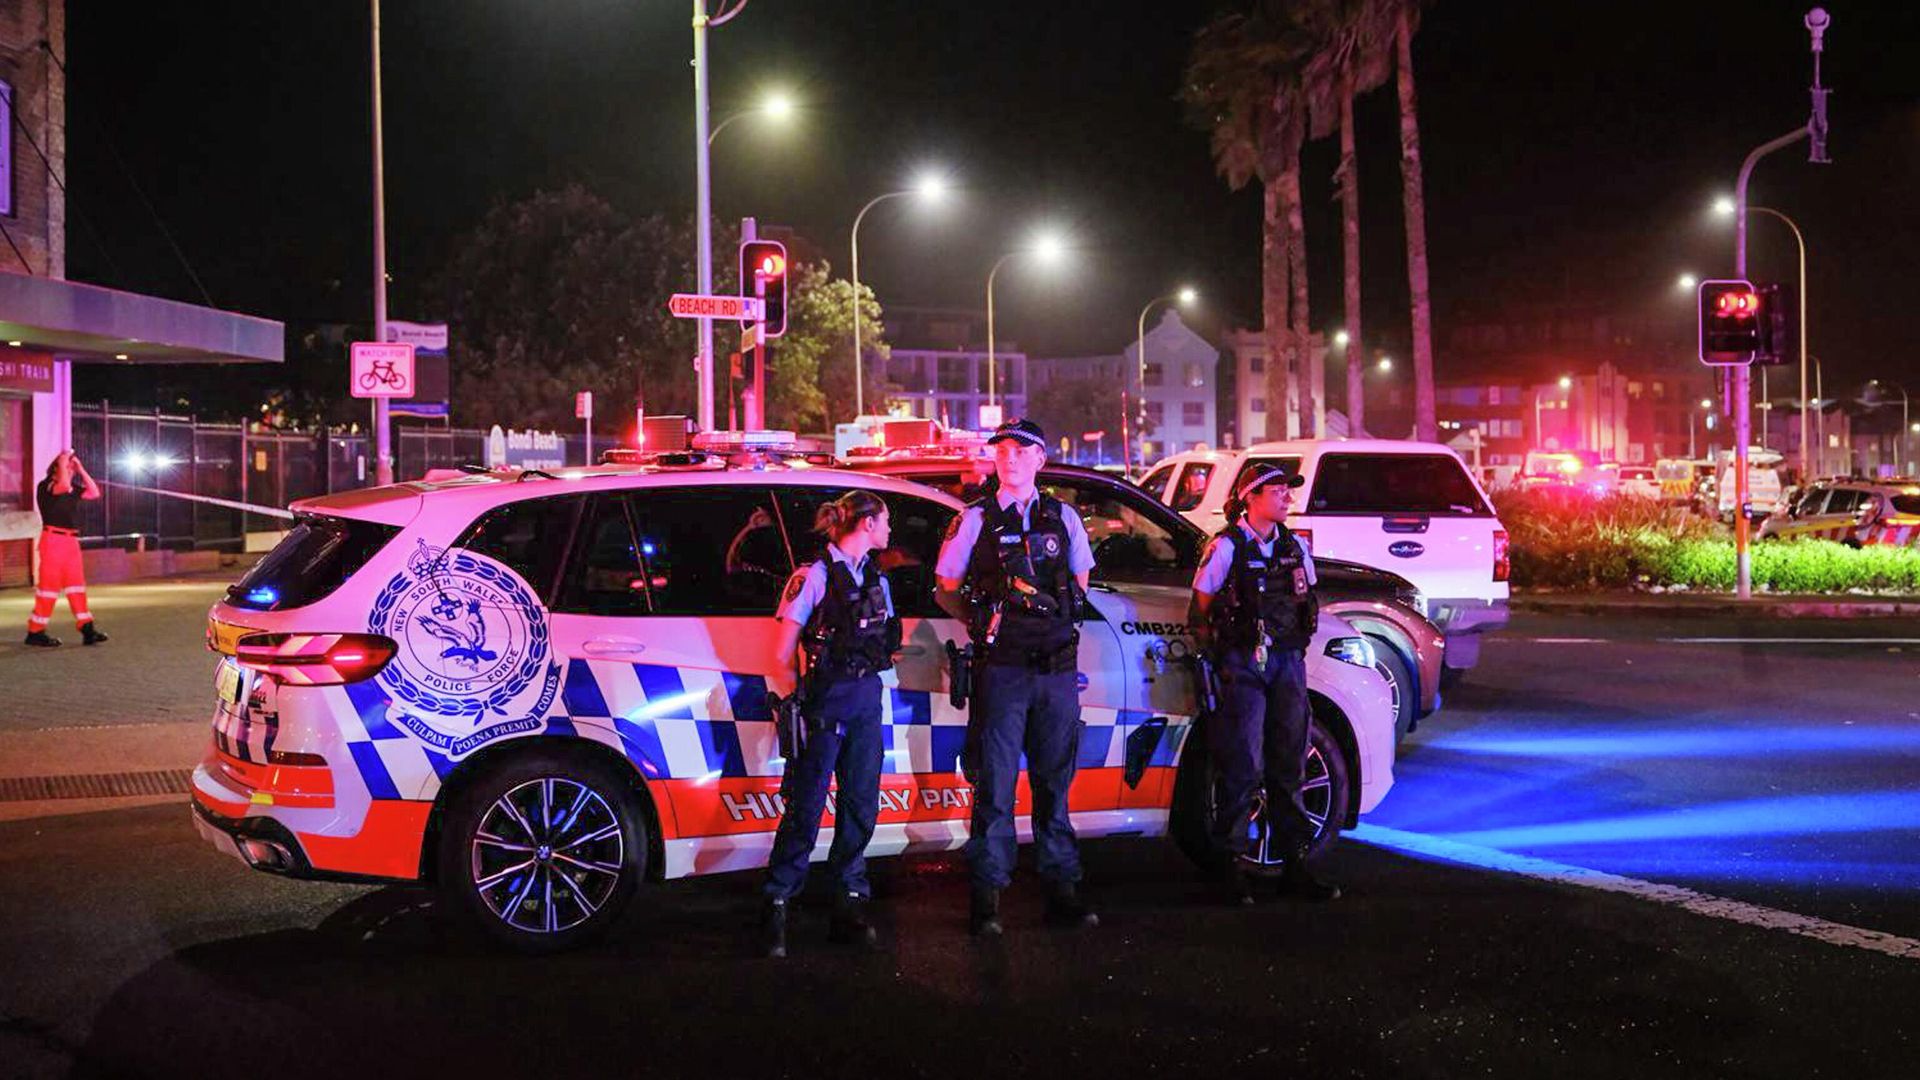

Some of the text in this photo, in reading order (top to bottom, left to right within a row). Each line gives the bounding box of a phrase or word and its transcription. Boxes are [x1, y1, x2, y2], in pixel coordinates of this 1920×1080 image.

[679, 299, 737, 316] BEACH RD
[21, 363, 49, 380] TRAIN
[508, 429, 557, 450] Bondi Beach
[394, 609, 408, 632] NEW
[411, 577, 451, 602] SOUTH
[1121, 622, 1193, 636] CMB22
[424, 649, 519, 692] POLICE FORCE
[406, 674, 558, 753] CULPAM POENA PREMIT COMES
